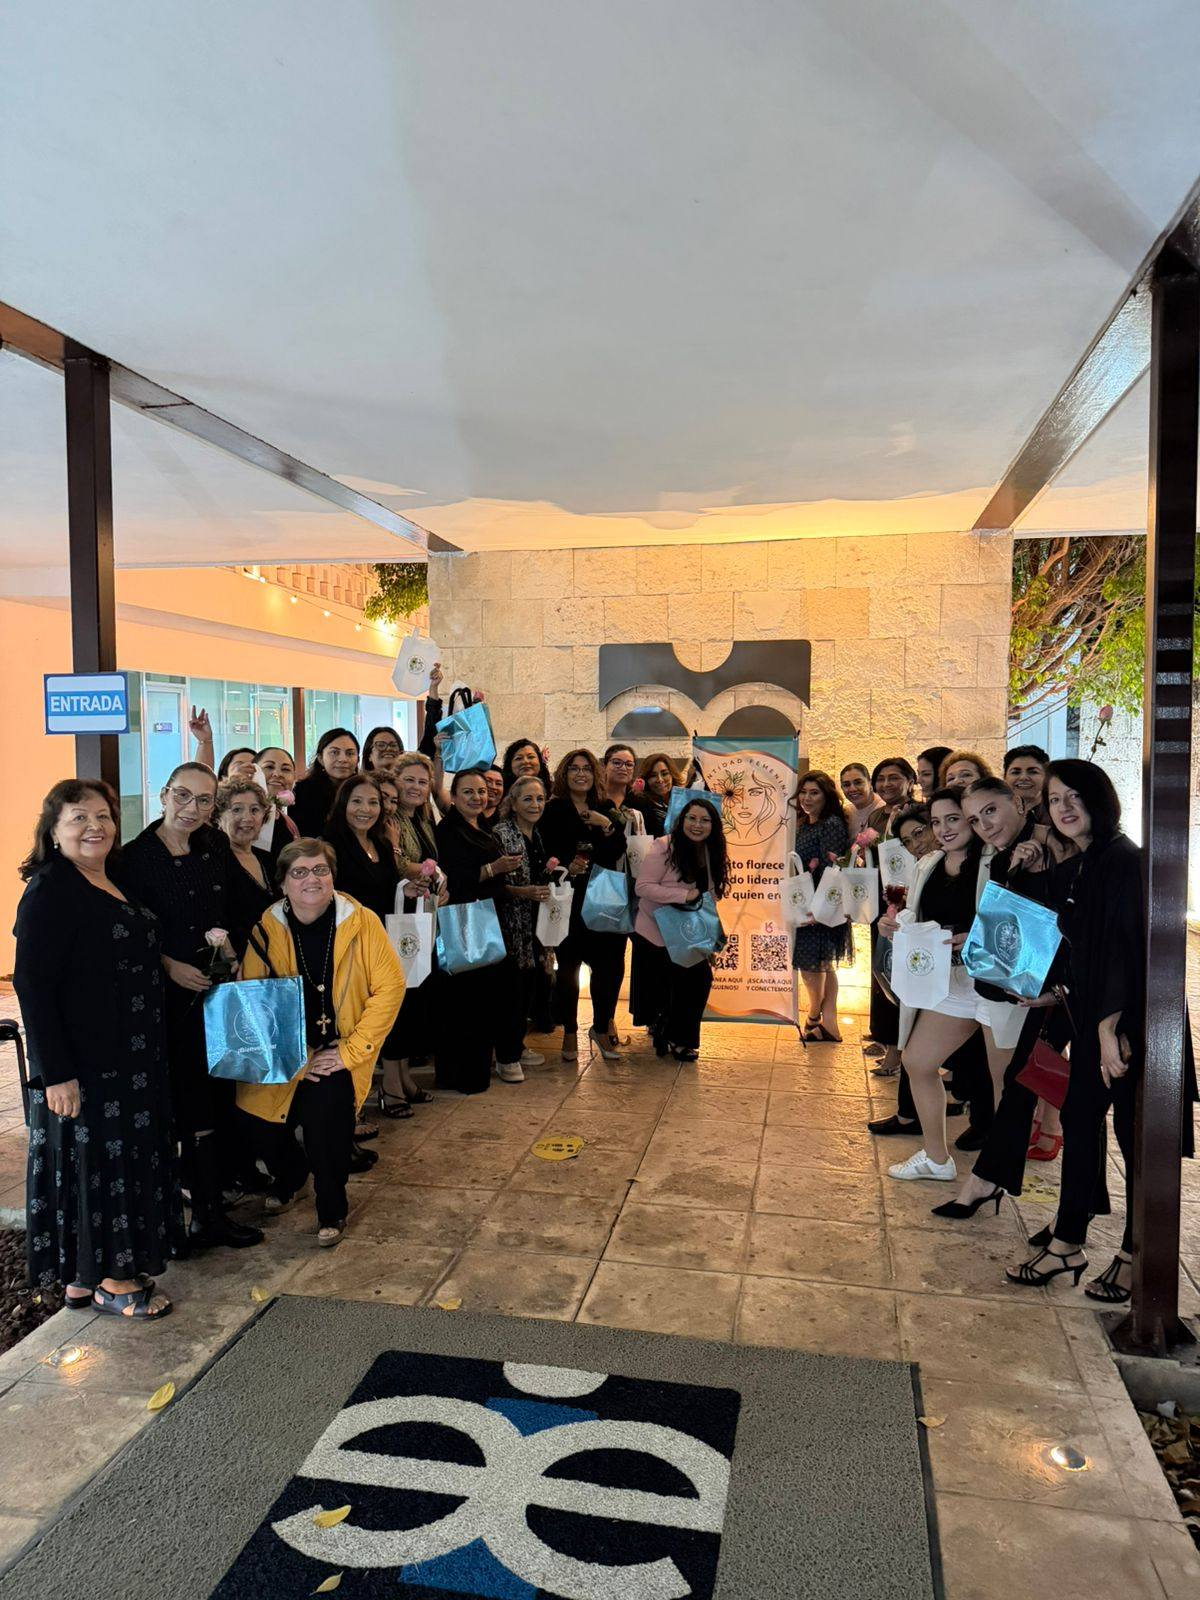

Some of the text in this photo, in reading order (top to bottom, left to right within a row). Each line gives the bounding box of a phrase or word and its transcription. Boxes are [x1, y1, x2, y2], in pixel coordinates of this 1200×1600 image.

[50, 695, 123, 712] ENTRADA
[746, 859, 785, 870] florece
[732, 889, 764, 901] quien
